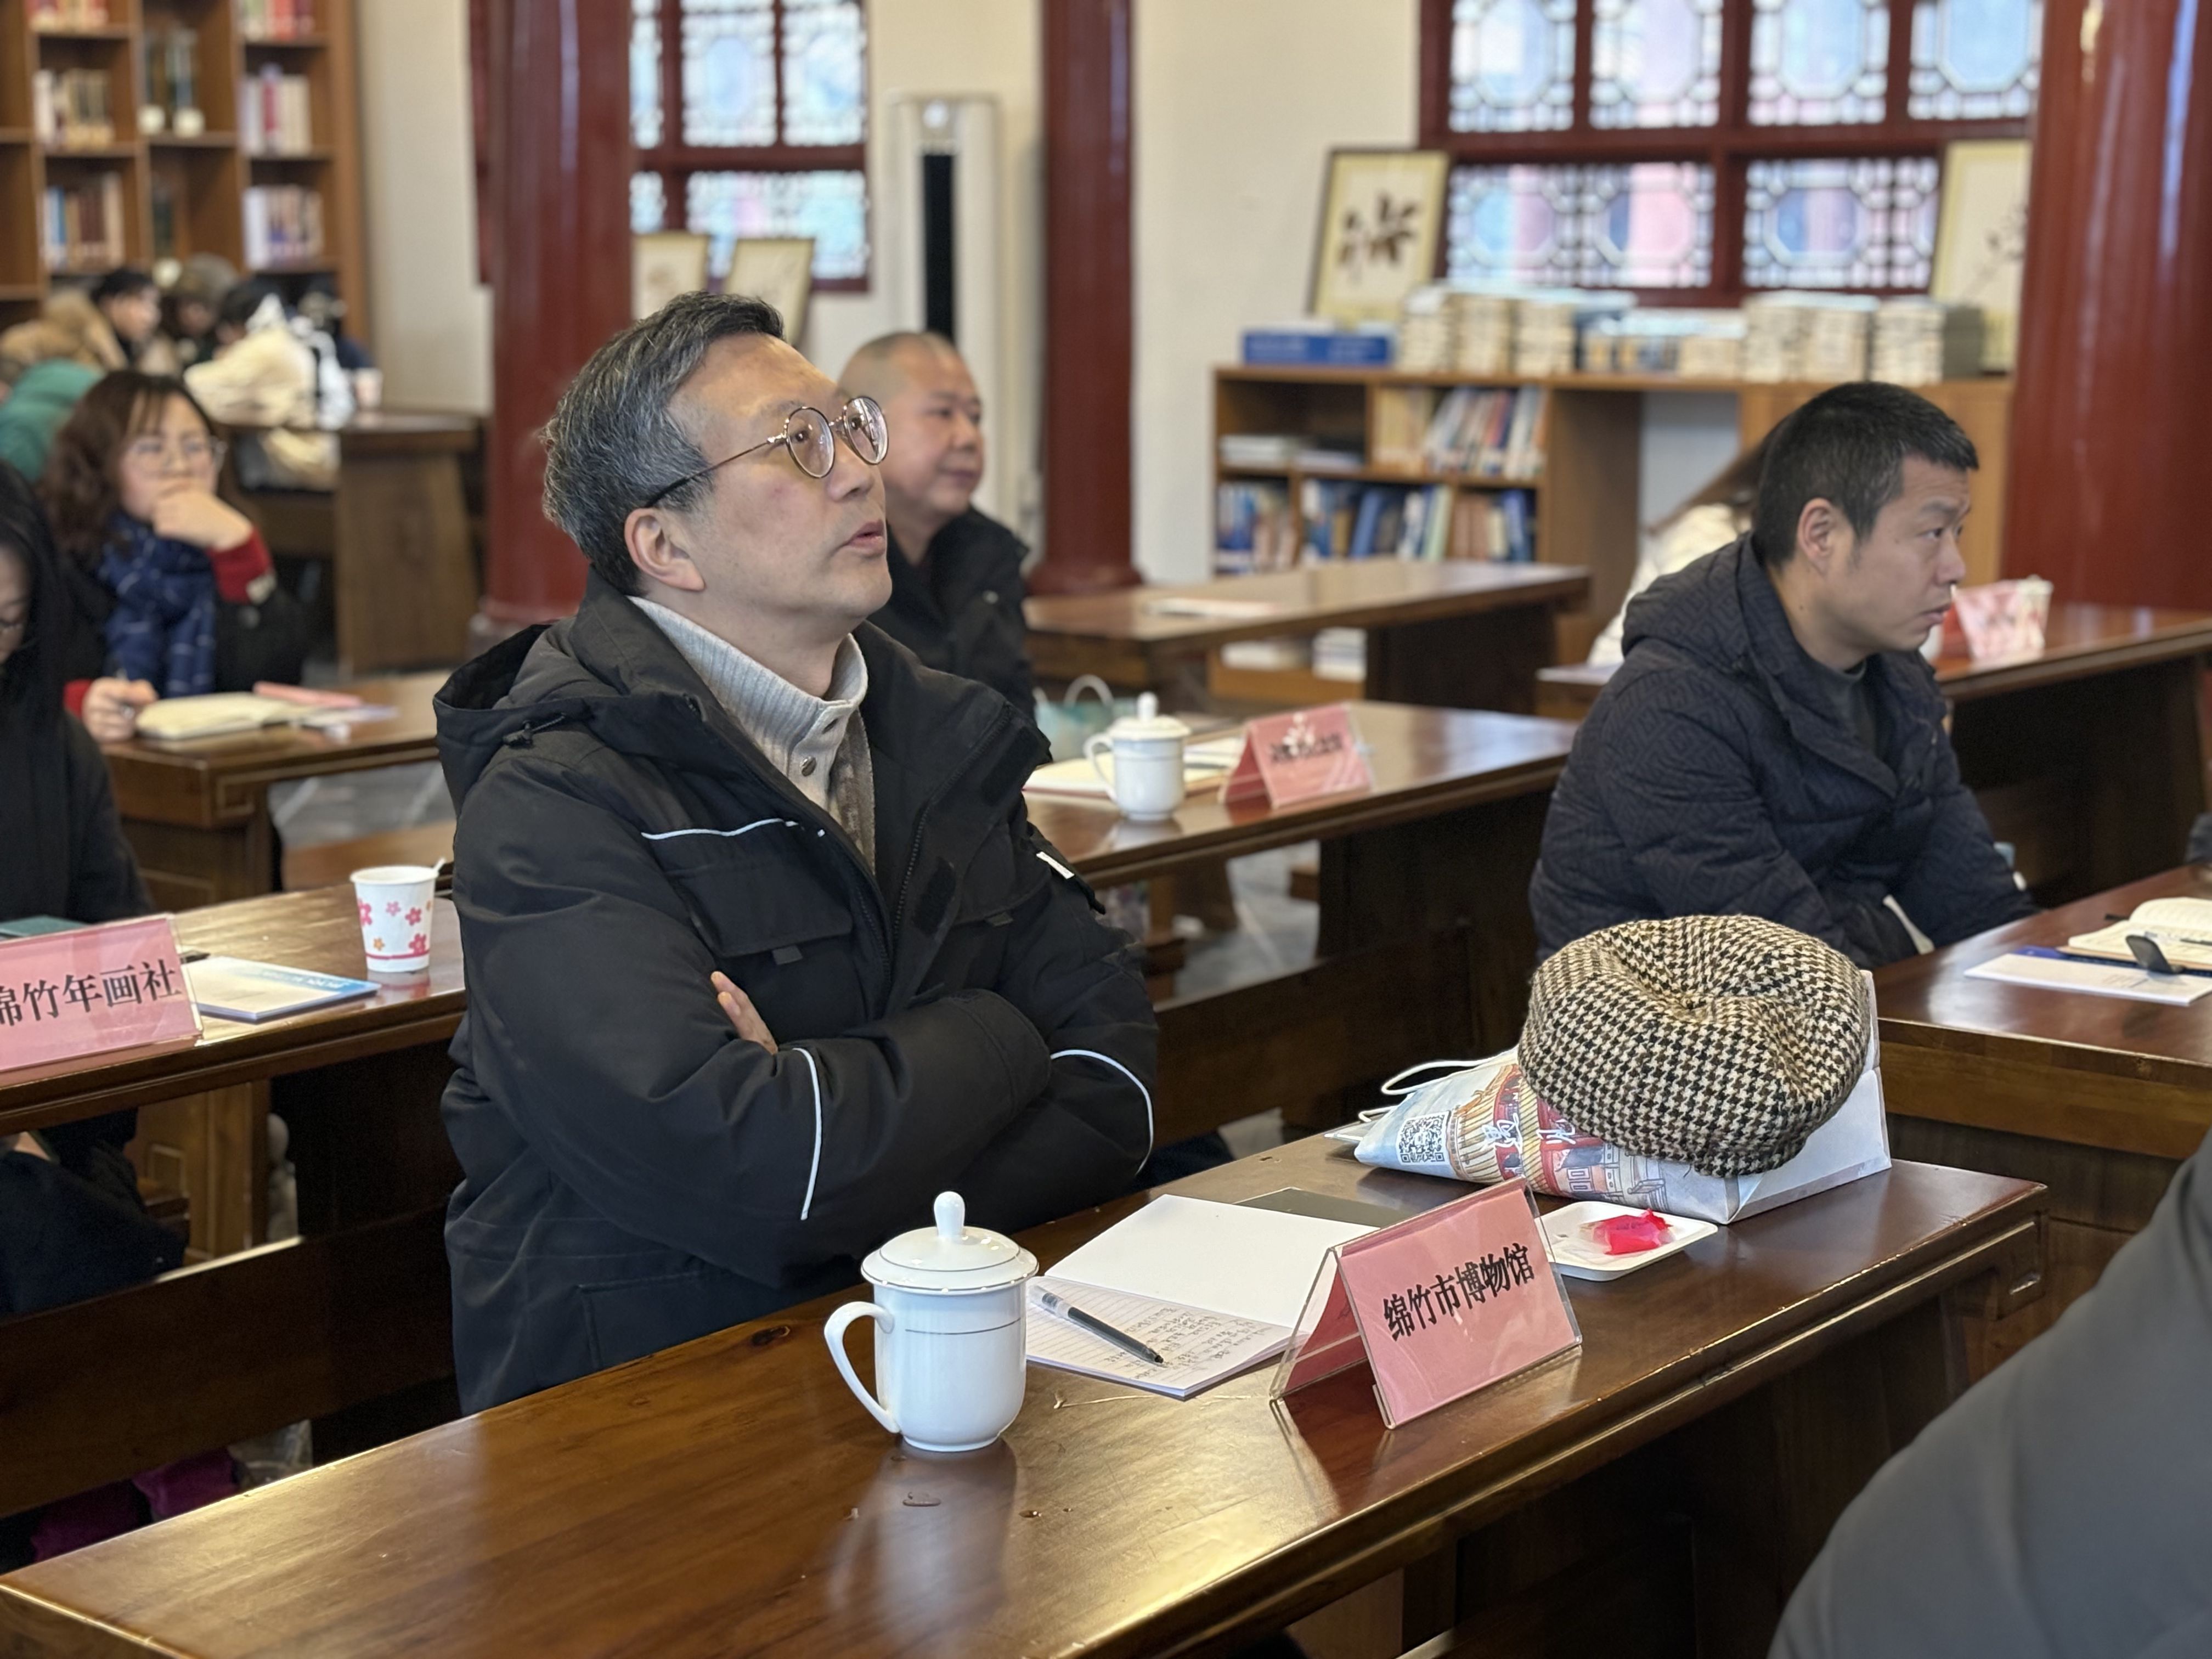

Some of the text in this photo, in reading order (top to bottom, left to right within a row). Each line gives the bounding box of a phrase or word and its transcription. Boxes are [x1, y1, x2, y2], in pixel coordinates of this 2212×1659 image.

[1383, 1243, 1535, 1341] 绵竹市博物馆
